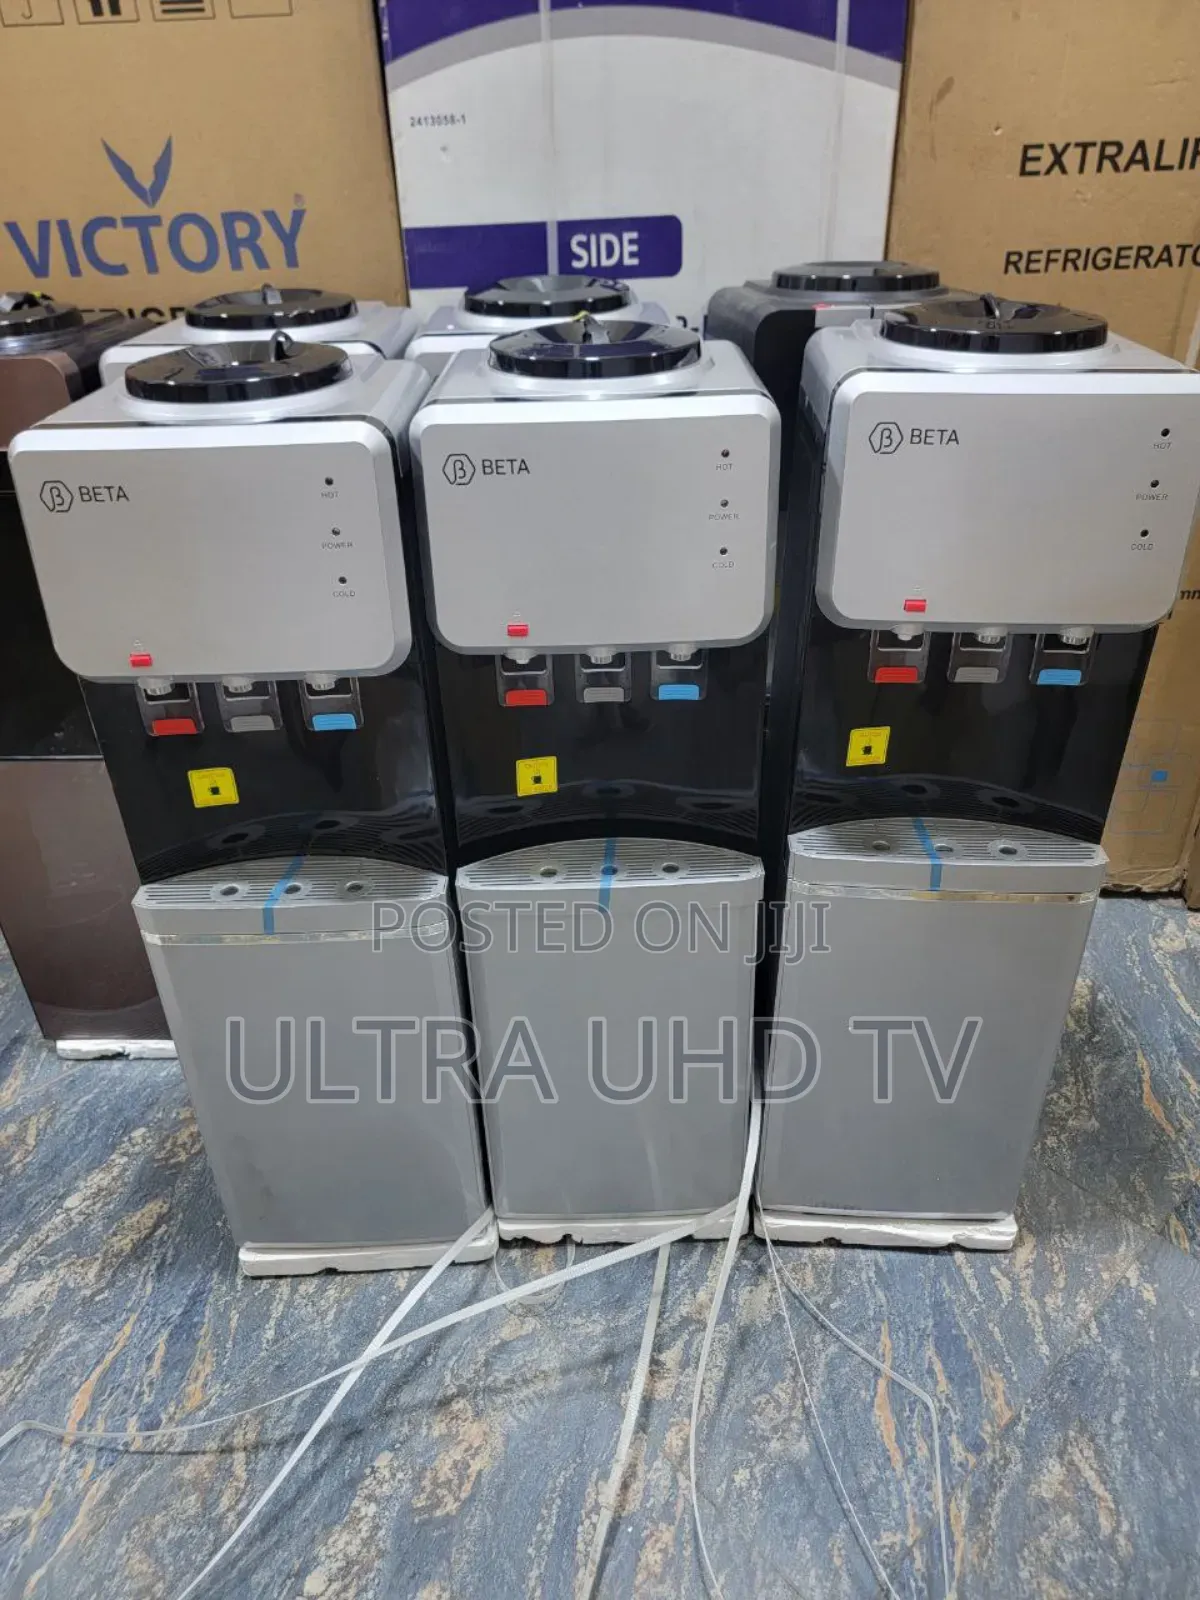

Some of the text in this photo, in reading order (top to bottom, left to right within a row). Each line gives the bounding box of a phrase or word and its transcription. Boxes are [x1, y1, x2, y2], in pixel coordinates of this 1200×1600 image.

[3, 209, 306, 279] VICTORY
[569, 230, 640, 269] SIDE
[909, 428, 960, 446] BETA
[481, 458, 531, 475] BETA
[78, 485, 130, 502] BETA
